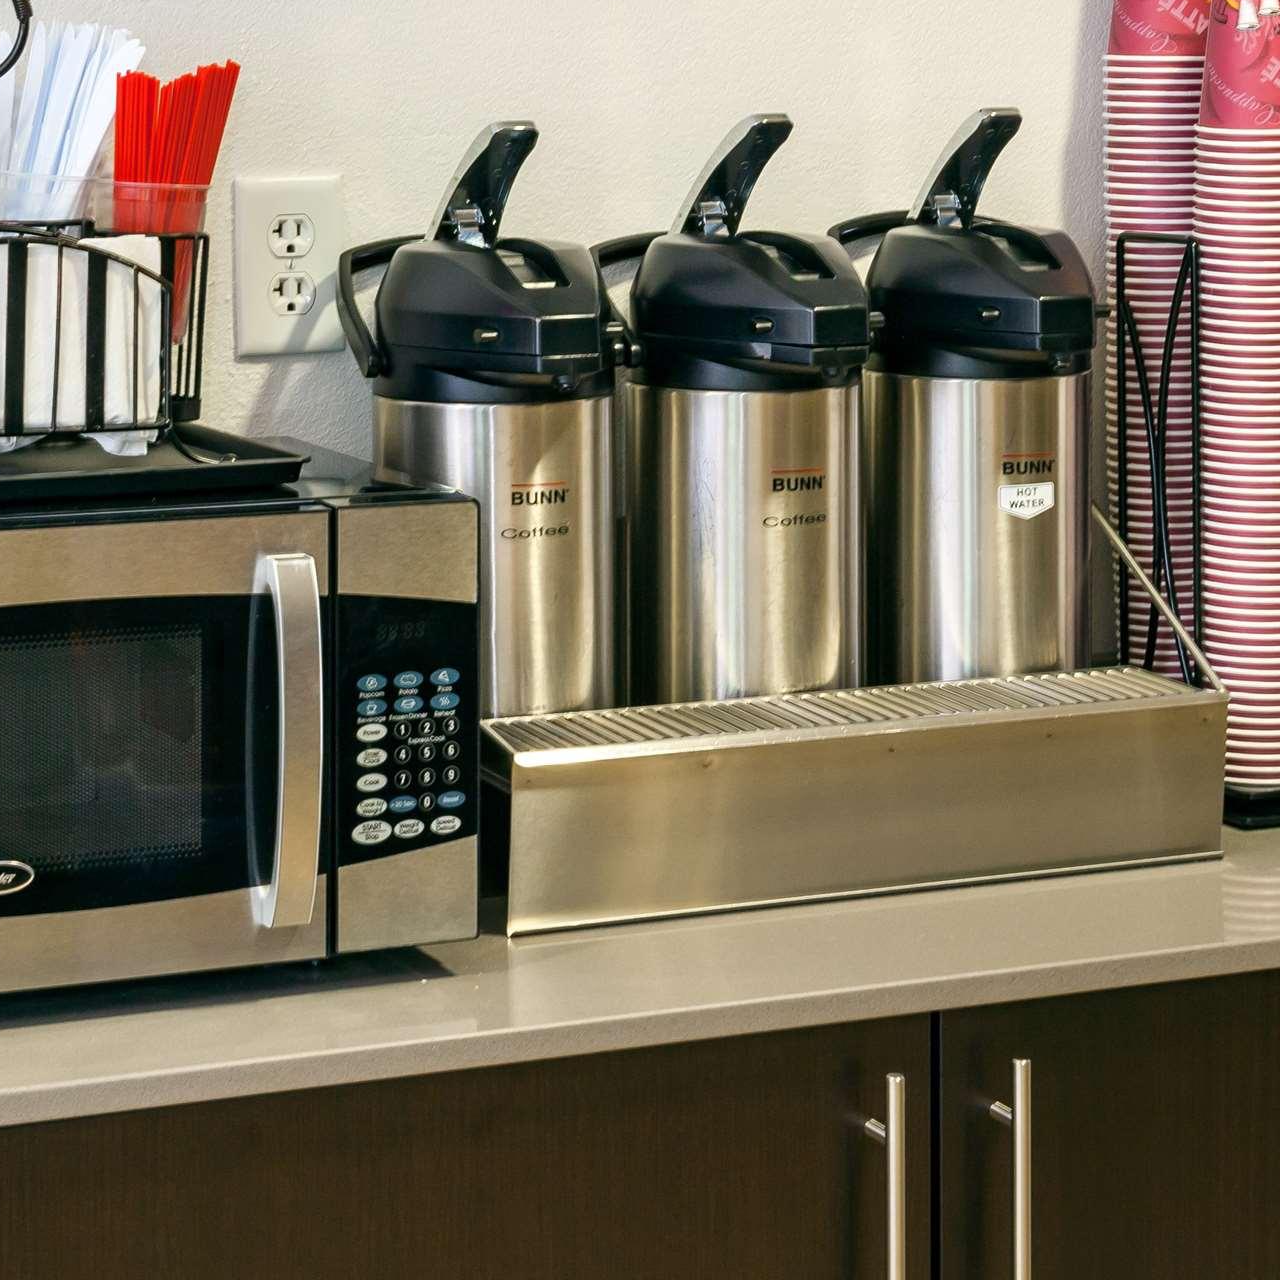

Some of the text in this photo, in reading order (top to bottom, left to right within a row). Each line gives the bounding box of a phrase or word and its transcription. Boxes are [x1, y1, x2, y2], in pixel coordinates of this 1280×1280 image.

[1003, 460, 1052, 475] BUNN
[772, 475, 823, 492] BUNN
[511, 488, 566, 506] BUNN
[1017, 487, 1037, 496] HOT
[1009, 498, 1045, 508] WATER
[762, 513, 827, 528] Coffee
[500, 525, 569, 539] Coffee
[400, 720, 455, 736] 1 2 3
[399, 744, 455, 760] 4 5 6
[400, 769, 455, 785] 7 8 9
[423, 796, 431, 808] 0
